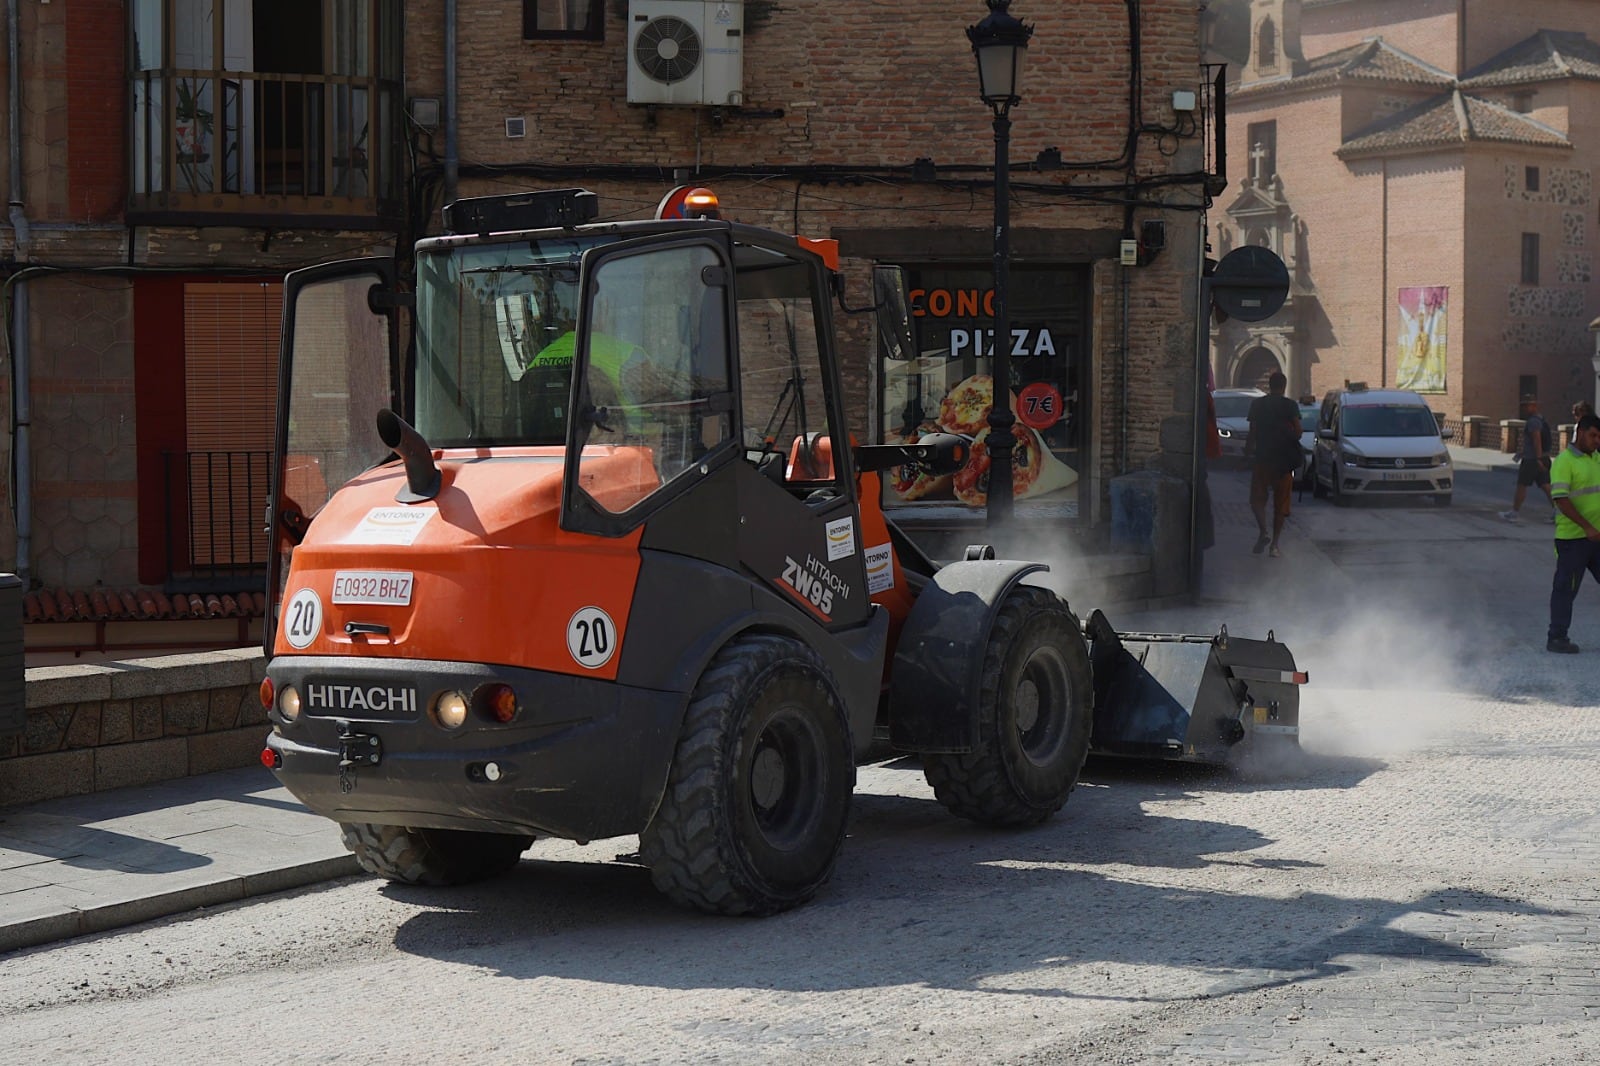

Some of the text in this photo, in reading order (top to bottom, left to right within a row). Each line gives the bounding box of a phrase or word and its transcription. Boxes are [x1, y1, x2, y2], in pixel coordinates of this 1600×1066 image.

[1026, 396, 1053, 415] 7€
[373, 512, 425, 520] ENTORNO
[380, 578, 409, 599] BHZ
[781, 556, 834, 615] ZW95
[805, 553, 850, 600] HITACHI
[290, 600, 313, 637] 20
[576, 617, 608, 657] 20
[308, 684, 417, 712] HITACHI
